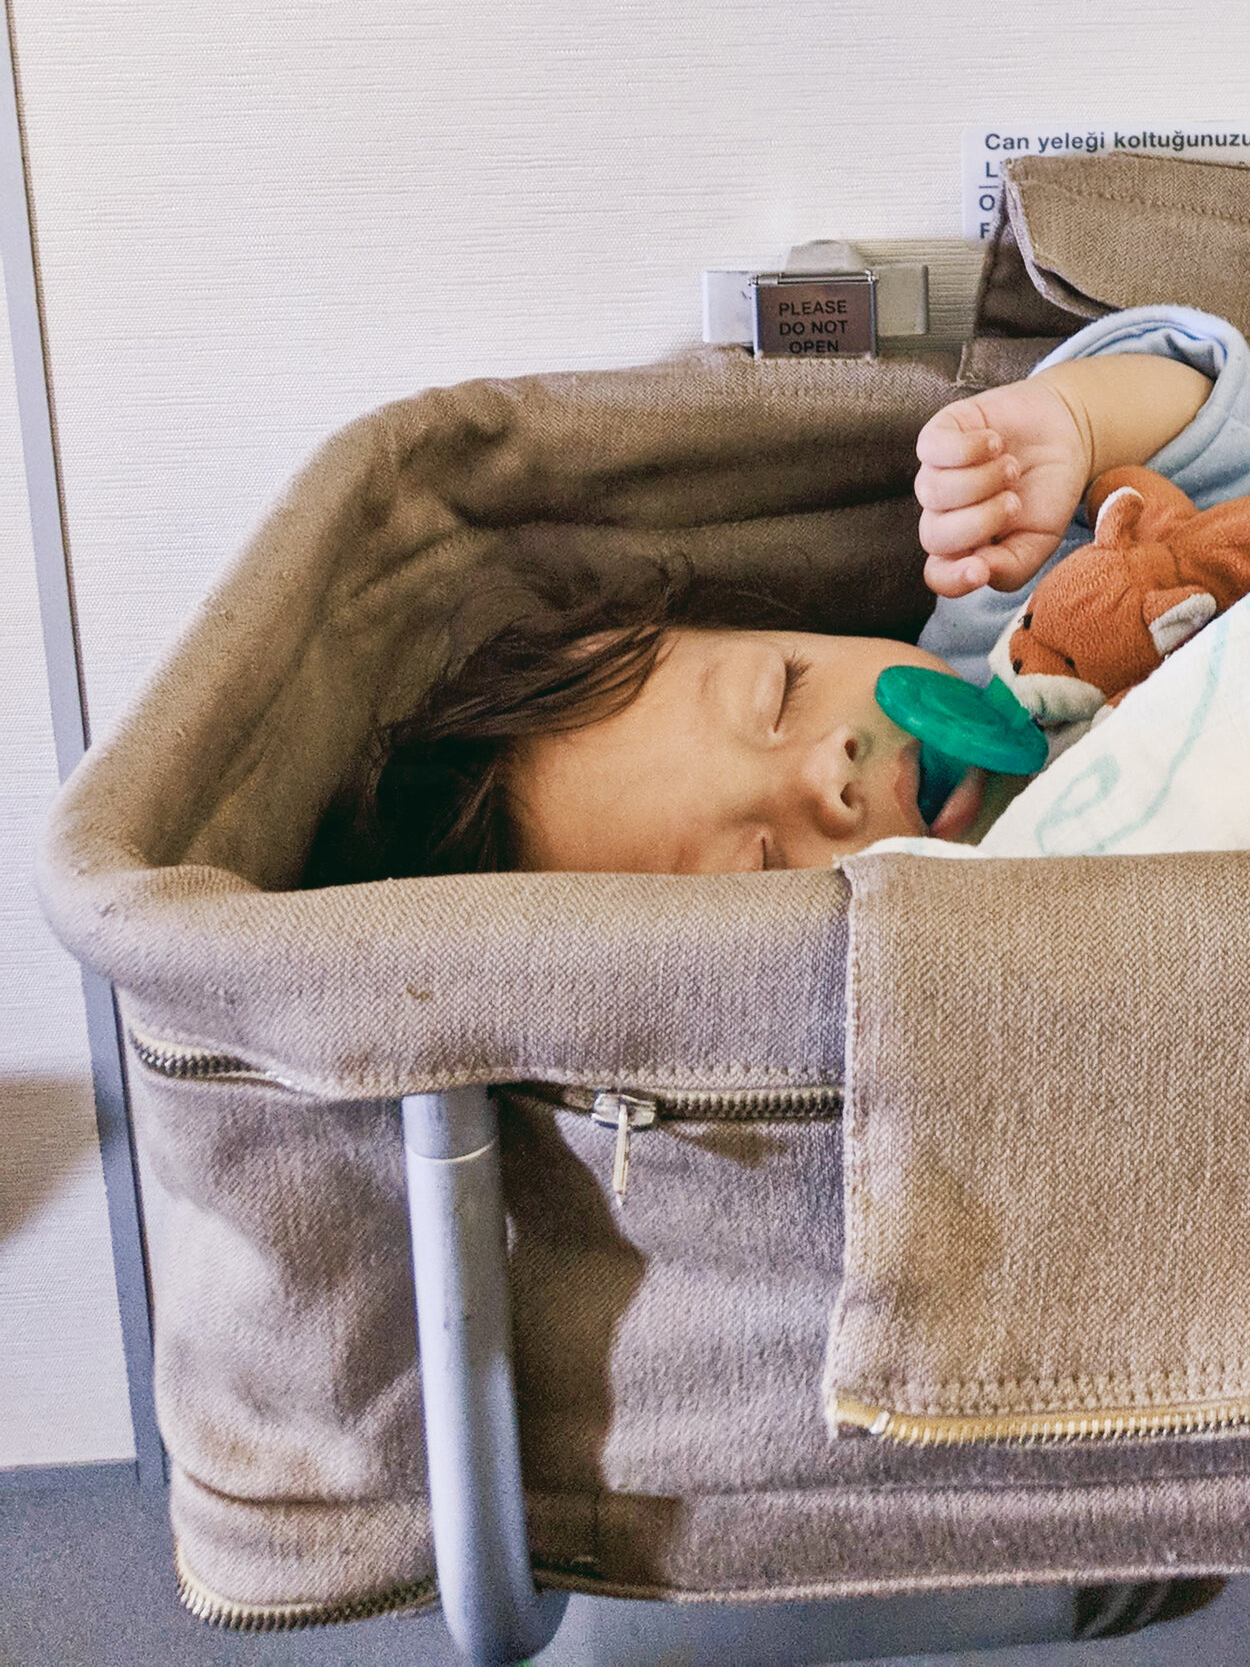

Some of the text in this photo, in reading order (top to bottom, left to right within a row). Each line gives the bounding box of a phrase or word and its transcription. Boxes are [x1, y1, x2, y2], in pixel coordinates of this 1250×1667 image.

[985, 133, 1029, 150] Can
[1038, 132, 1105, 153] yeleği
[779, 299, 847, 316] PLEASE
[779, 320, 848, 335] DO NOT
[789, 340, 839, 354] OPEN
